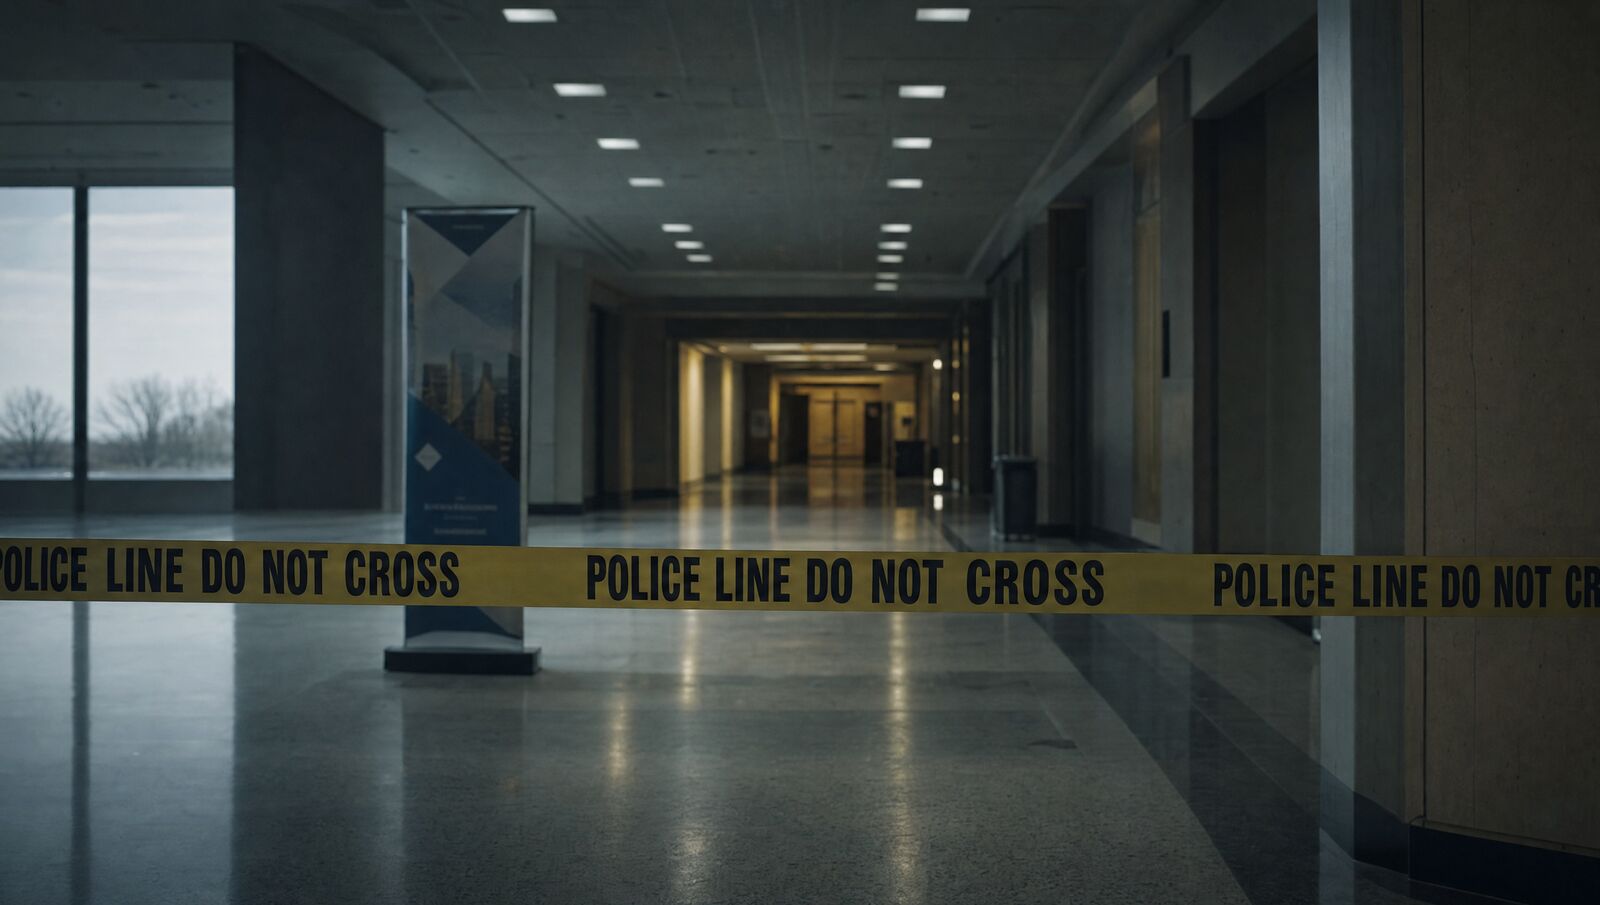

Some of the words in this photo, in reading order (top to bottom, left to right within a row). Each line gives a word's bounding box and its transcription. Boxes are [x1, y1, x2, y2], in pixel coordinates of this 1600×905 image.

[0, 546, 87, 592] OLICE
[107, 547, 183, 593] LINE
[202, 548, 245, 594] DO
[263, 549, 328, 595] NOT
[345, 550, 459, 598] CROSS
[587, 555, 700, 601] POLICE
[716, 557, 790, 602] LINE
[807, 558, 852, 603] DO
[872, 559, 943, 604] NOT
[967, 559, 1104, 606] CROSS
[1214, 563, 1335, 608] POLICE
[1353, 564, 1427, 608] LINE
[1442, 565, 1480, 608] DO
[1495, 565, 1552, 608] NOT
